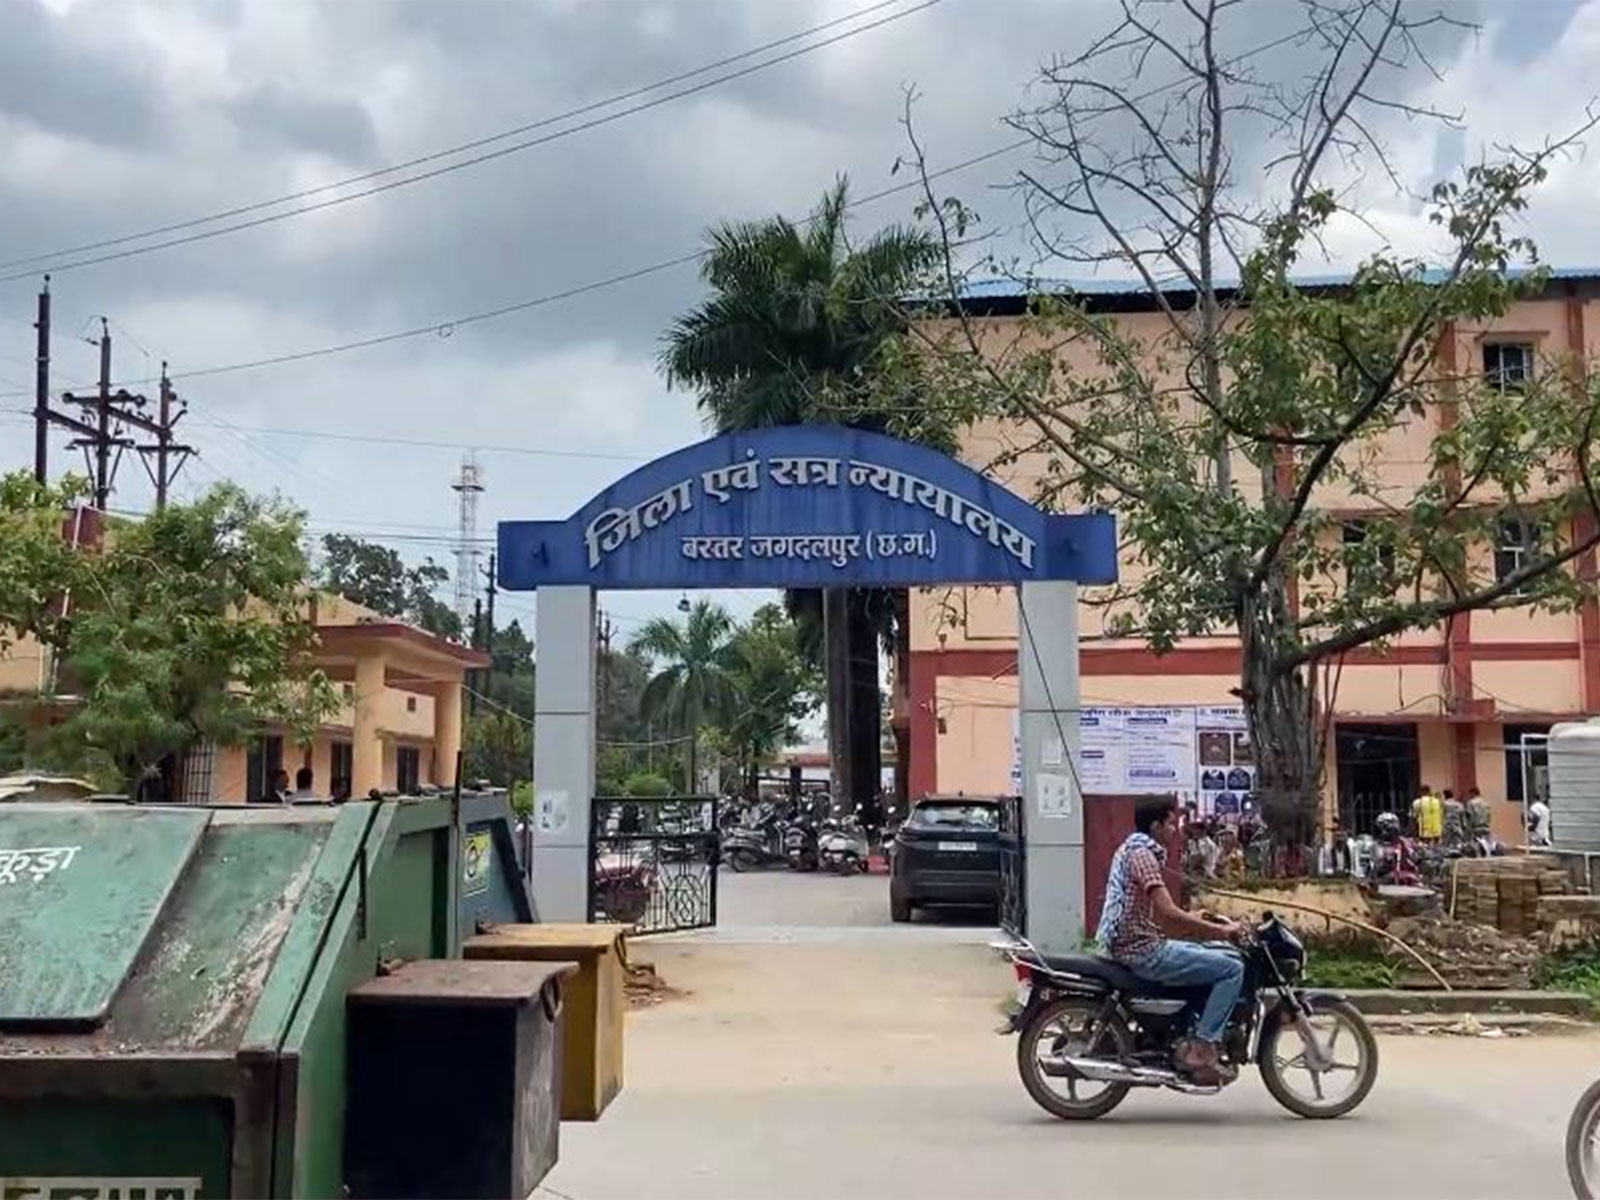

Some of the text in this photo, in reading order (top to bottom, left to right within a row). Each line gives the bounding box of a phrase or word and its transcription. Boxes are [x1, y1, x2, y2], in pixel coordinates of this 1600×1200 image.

[585, 448, 1037, 570] जिला एवं सत्र न्यायालय
[682, 536, 744, 559] बस्तर
[750, 535, 860, 568] जगदलपुर
